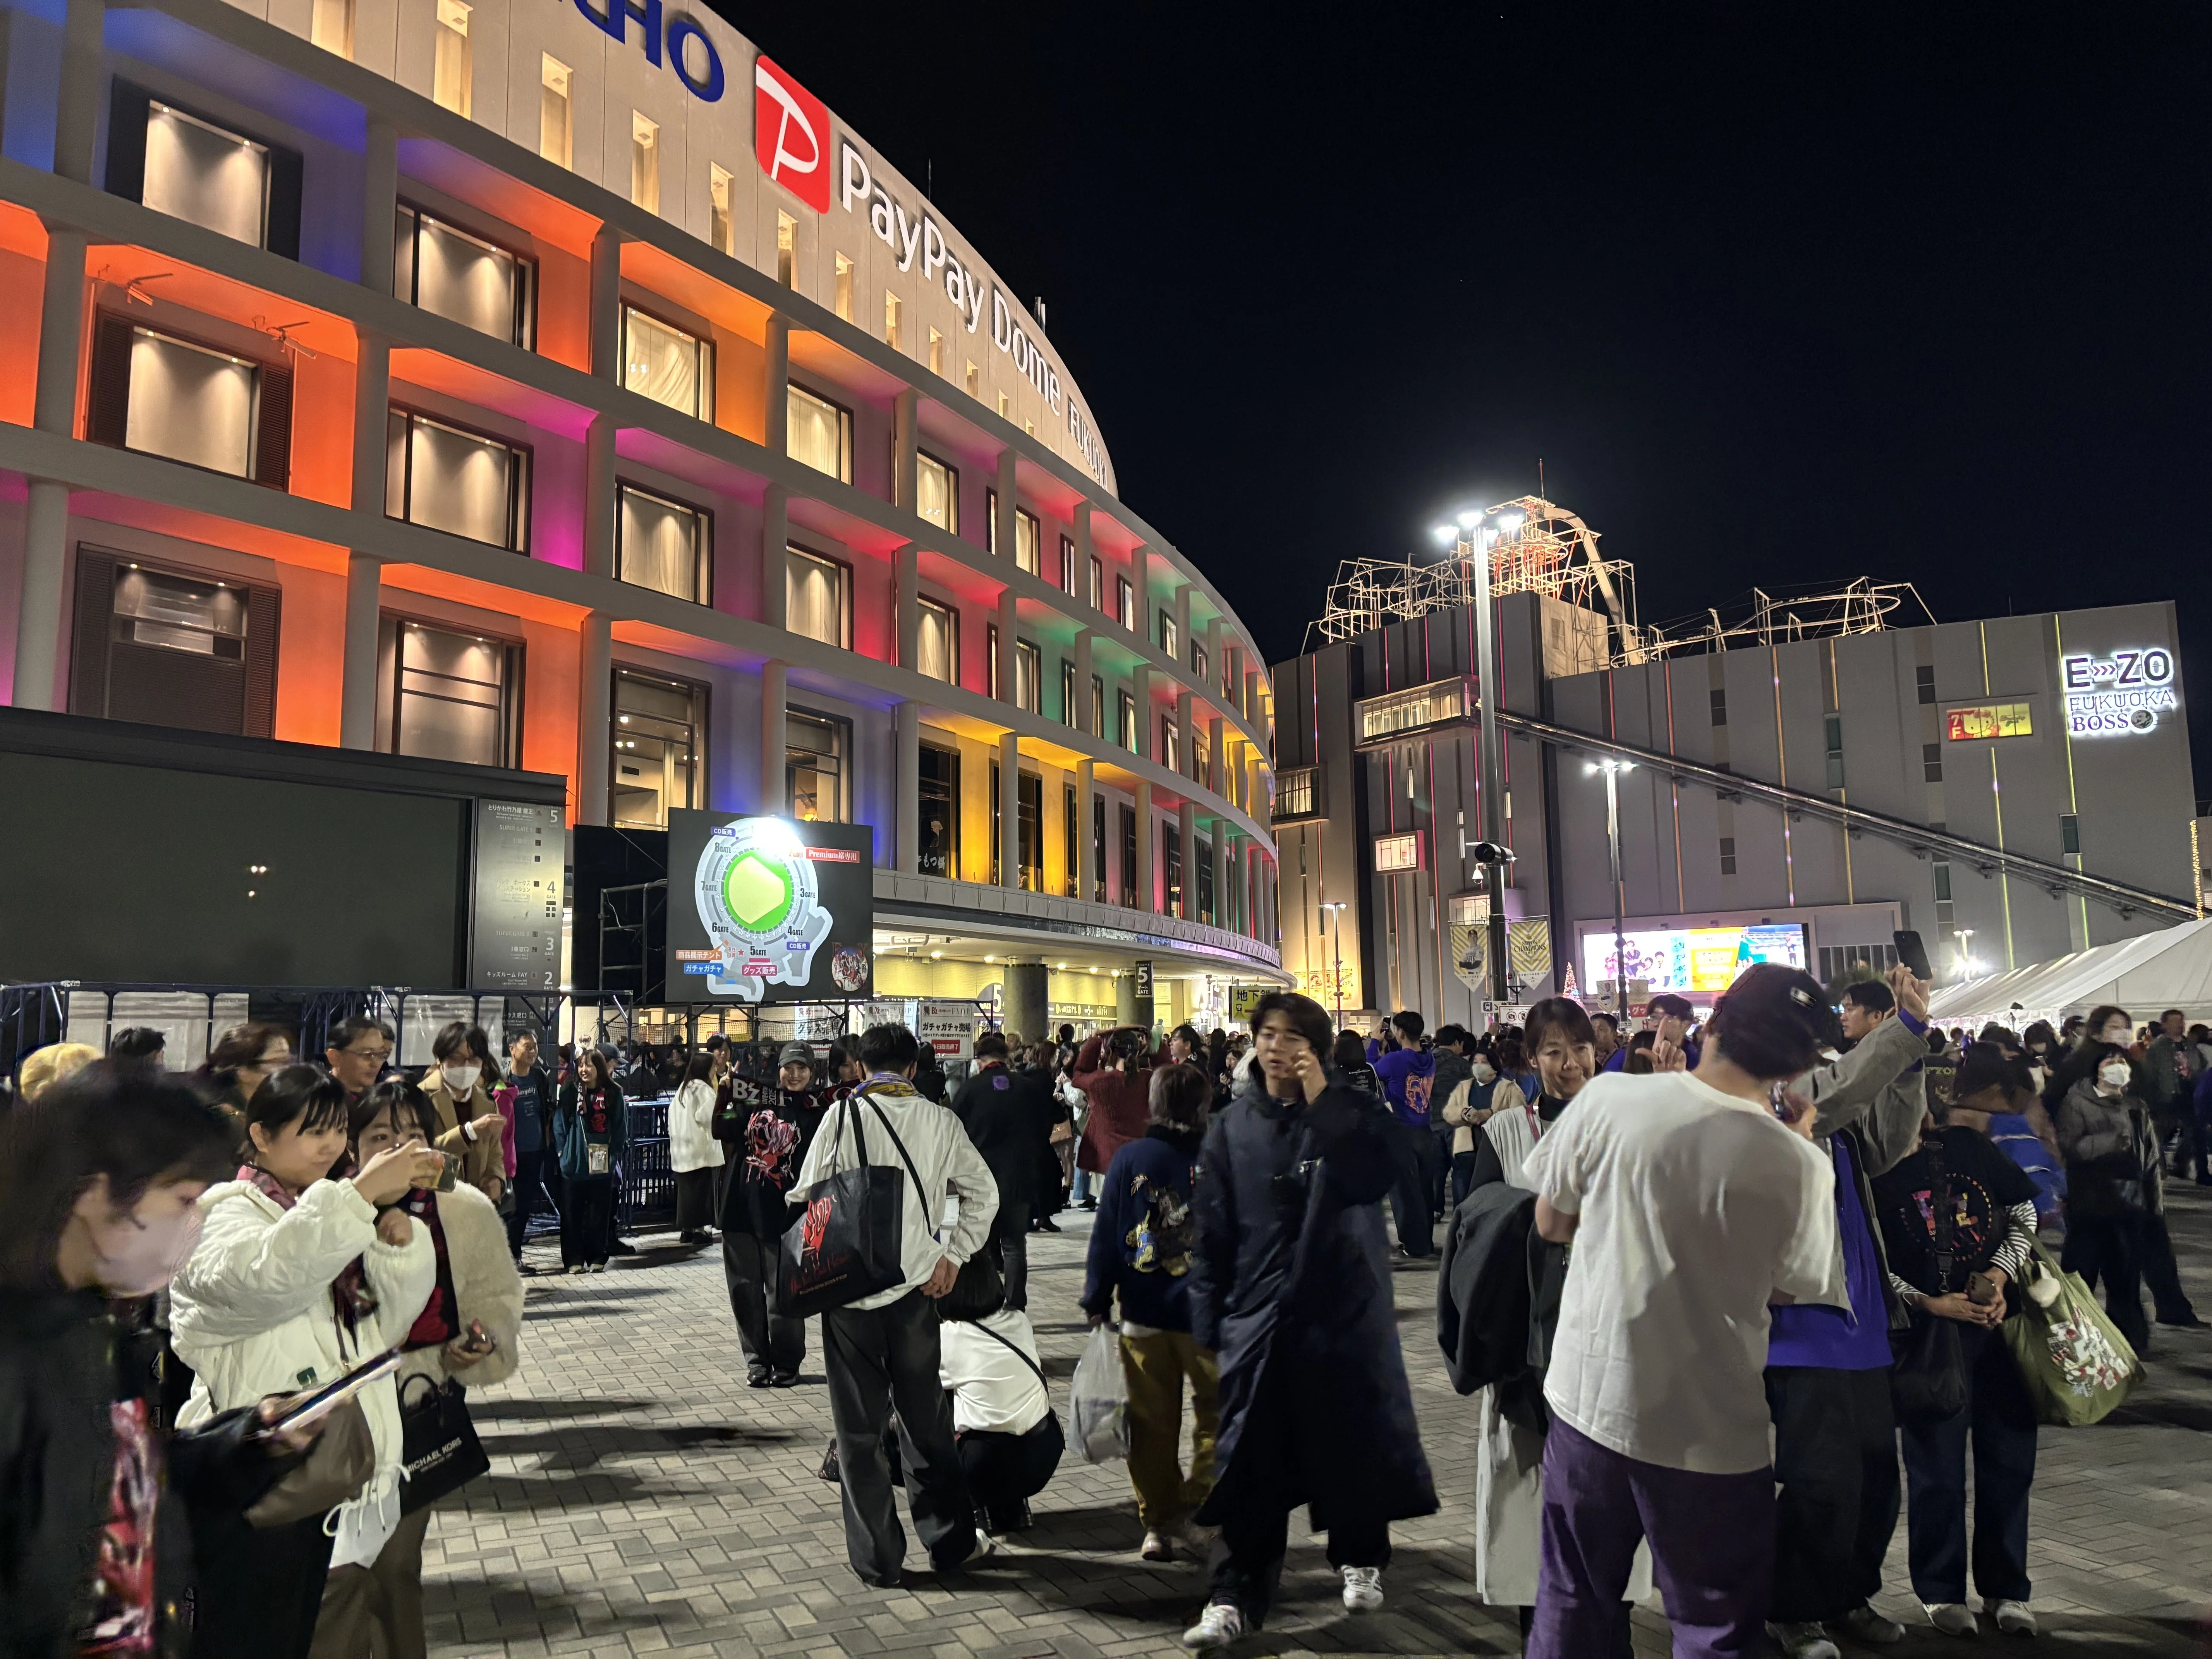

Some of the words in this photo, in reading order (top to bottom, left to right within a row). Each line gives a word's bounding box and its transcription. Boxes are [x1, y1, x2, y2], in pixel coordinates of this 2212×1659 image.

[843, 143, 984, 334] PayPay
[994, 289, 1060, 417] Dome
[1070, 401, 1108, 492] FUKUOKA
[2070, 691, 2174, 711] FUKUOKA
[2073, 713, 2128, 731] BOSS
[550, 810, 558, 823] 5
[714, 842, 732, 854] 8GATE
[547, 881, 556, 893] 4
[701, 880, 717, 891] 7GATE
[800, 888, 816, 898] 3GATE
[712, 922, 729, 933] 6GATE
[787, 926, 803, 936] 4GATE
[546, 937, 554, 950] 3
[1514, 943, 1546, 952] CHAMPIONS
[678, 951, 720, 960] 商品展示テント
[750, 946, 766, 956] 5GATE
[685, 965, 721, 973] ガチャガチャ
[744, 967, 776, 975] グッズ販売
[1138, 967, 1148, 983] 5
[544, 971, 553, 985] 2
[922, 1022, 971, 1032] ガチャガチャ売場
[733, 1078, 760, 1103] B'z
[408, 1449, 442, 1473] MICHAEL
